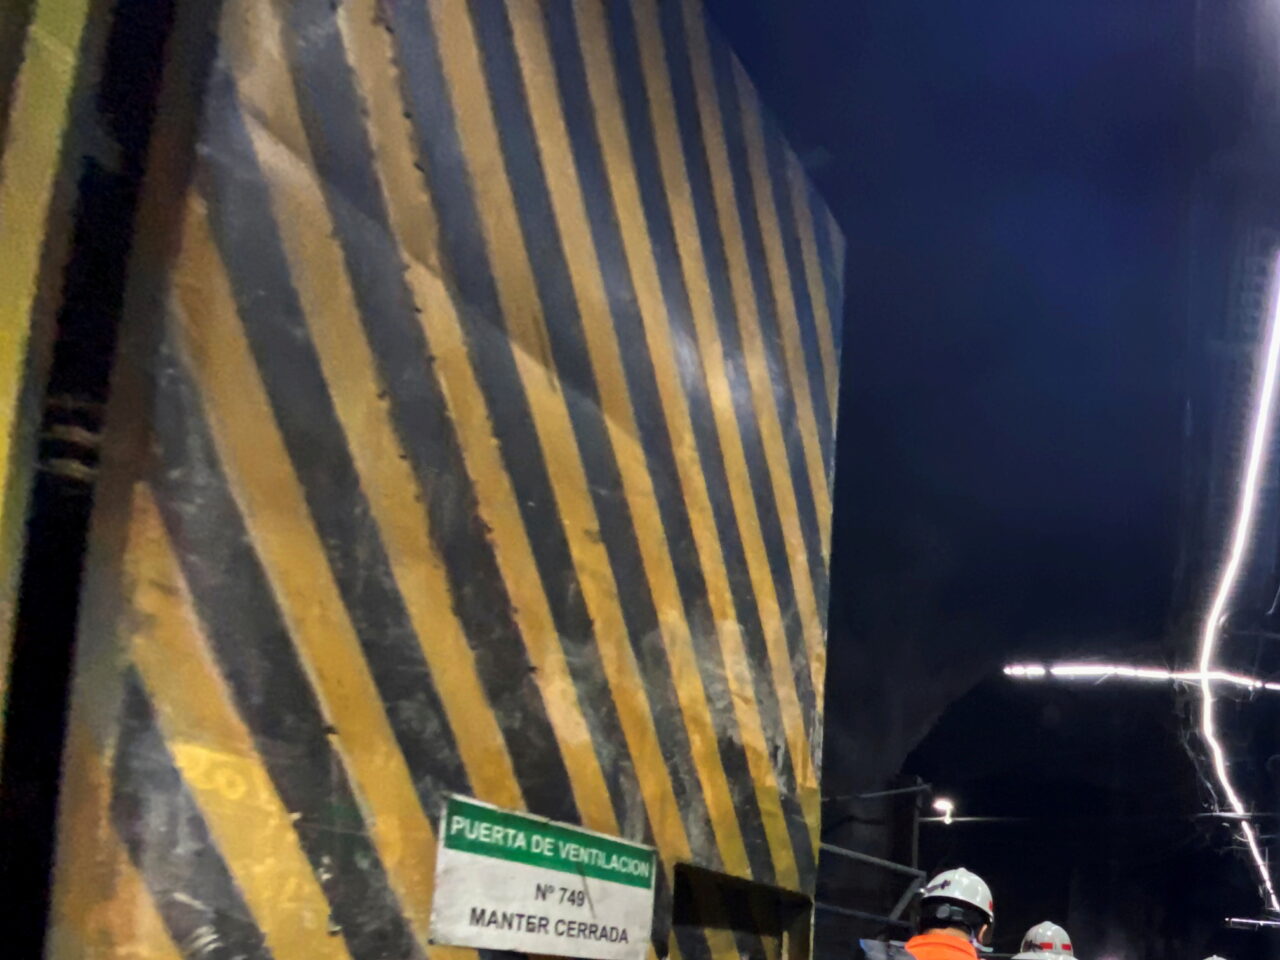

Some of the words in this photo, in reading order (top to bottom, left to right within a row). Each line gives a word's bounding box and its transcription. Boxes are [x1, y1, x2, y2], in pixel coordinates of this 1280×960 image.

[450, 815, 527, 850] PUERTA
[531, 835, 555, 857] DE
[559, 843, 649, 878] VENTILACION
[559, 887, 585, 908] 749
[469, 907, 550, 935] MANTER
[554, 919, 629, 944] CERRADA
